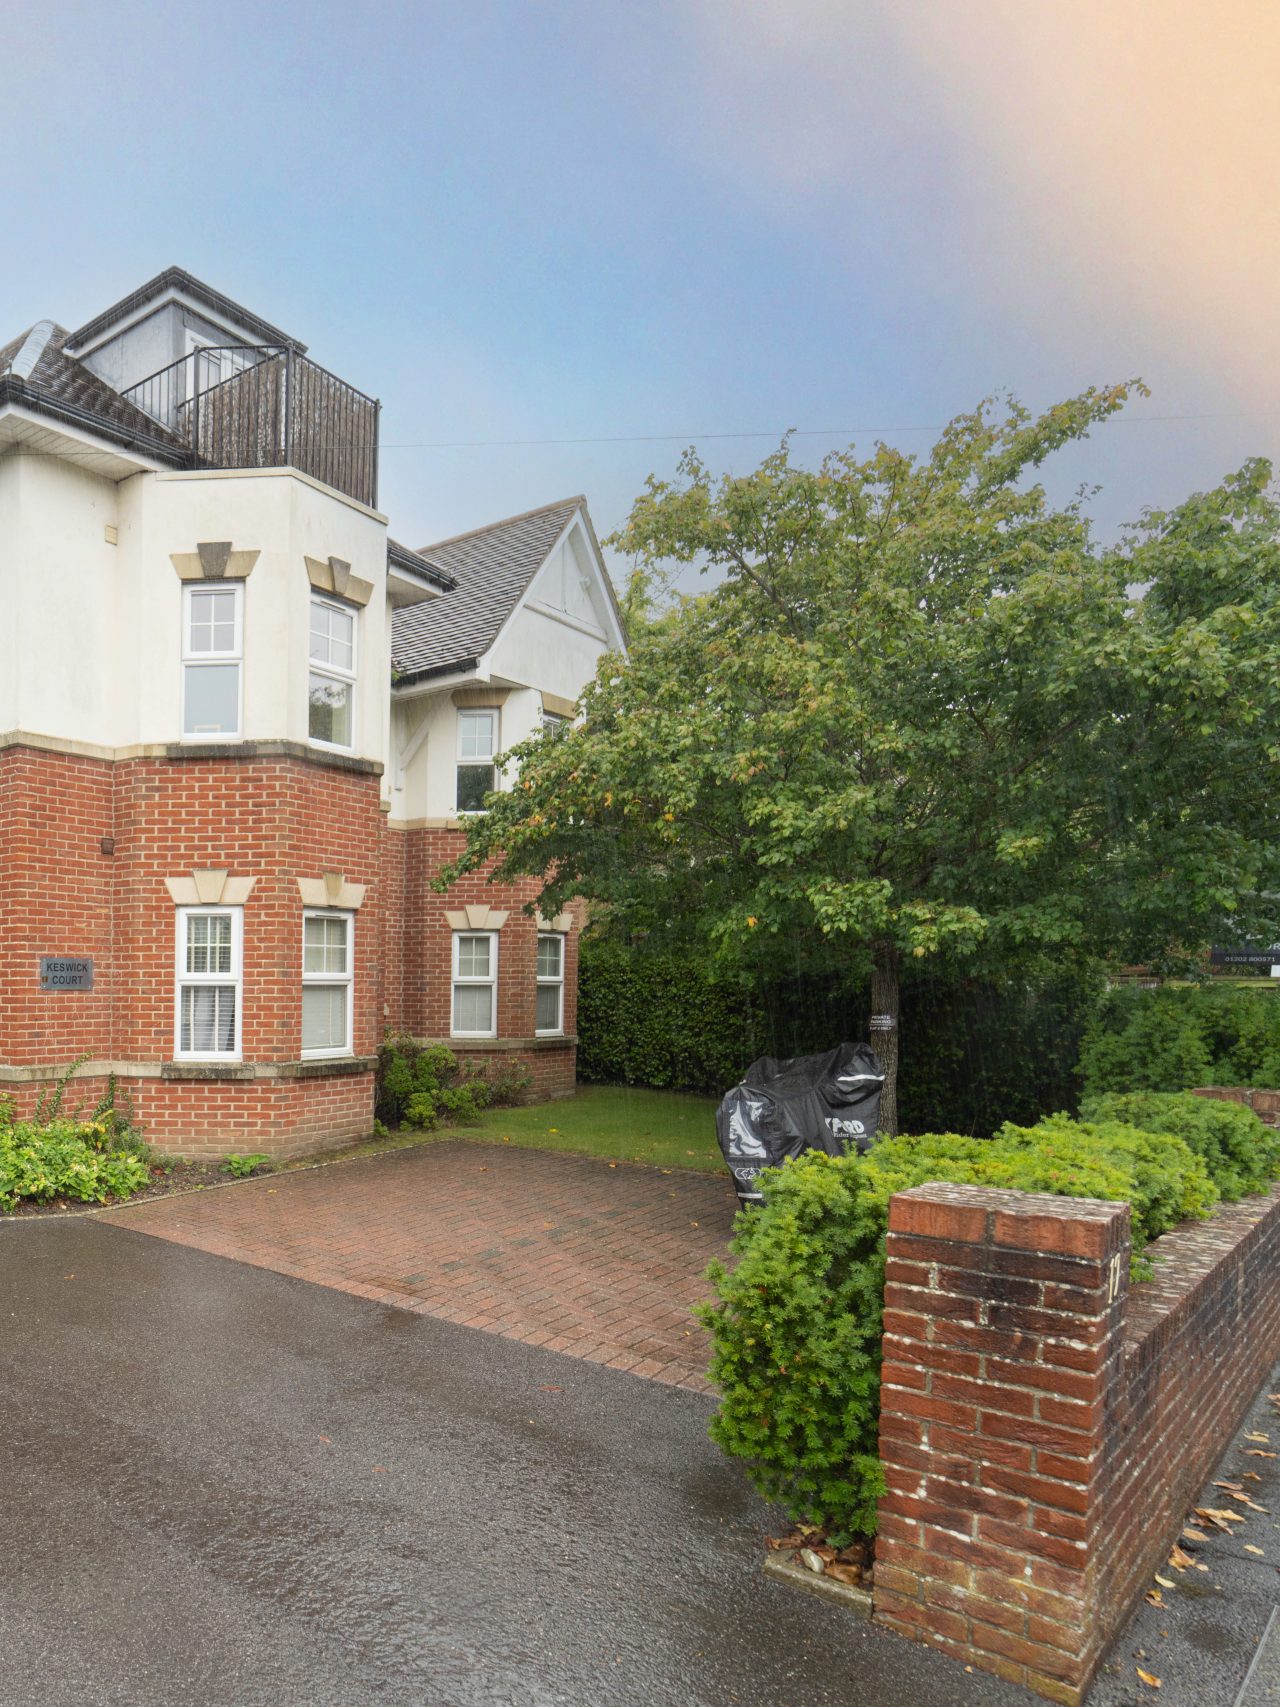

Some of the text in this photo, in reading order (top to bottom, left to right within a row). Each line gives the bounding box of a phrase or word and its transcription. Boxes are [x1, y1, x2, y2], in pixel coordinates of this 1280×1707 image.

[46, 963, 88, 972] KESWICK
[51, 975, 83, 985] COURT
[1108, 1252, 1121, 1304] 17
